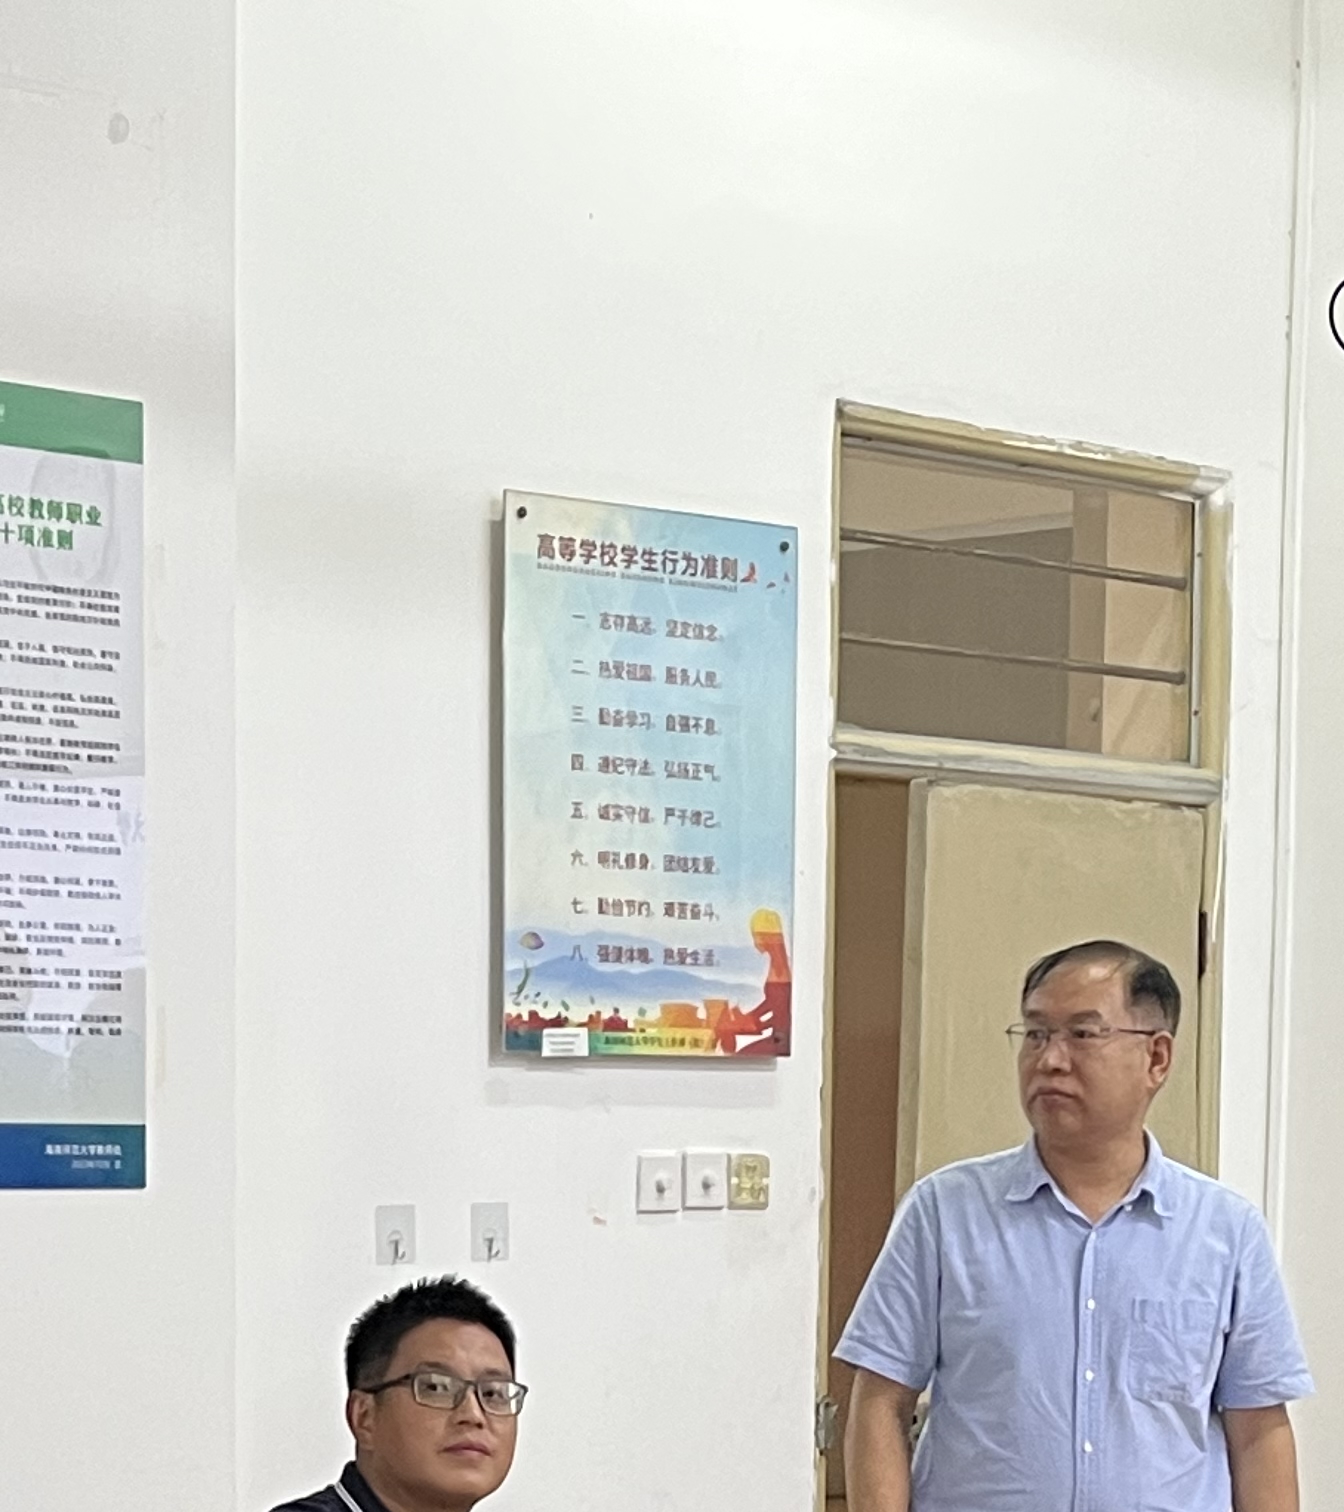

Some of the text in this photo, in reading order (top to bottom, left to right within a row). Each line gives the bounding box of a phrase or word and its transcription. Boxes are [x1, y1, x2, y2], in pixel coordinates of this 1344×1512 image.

[537, 533, 739, 583] 高等学校学生行为准则
